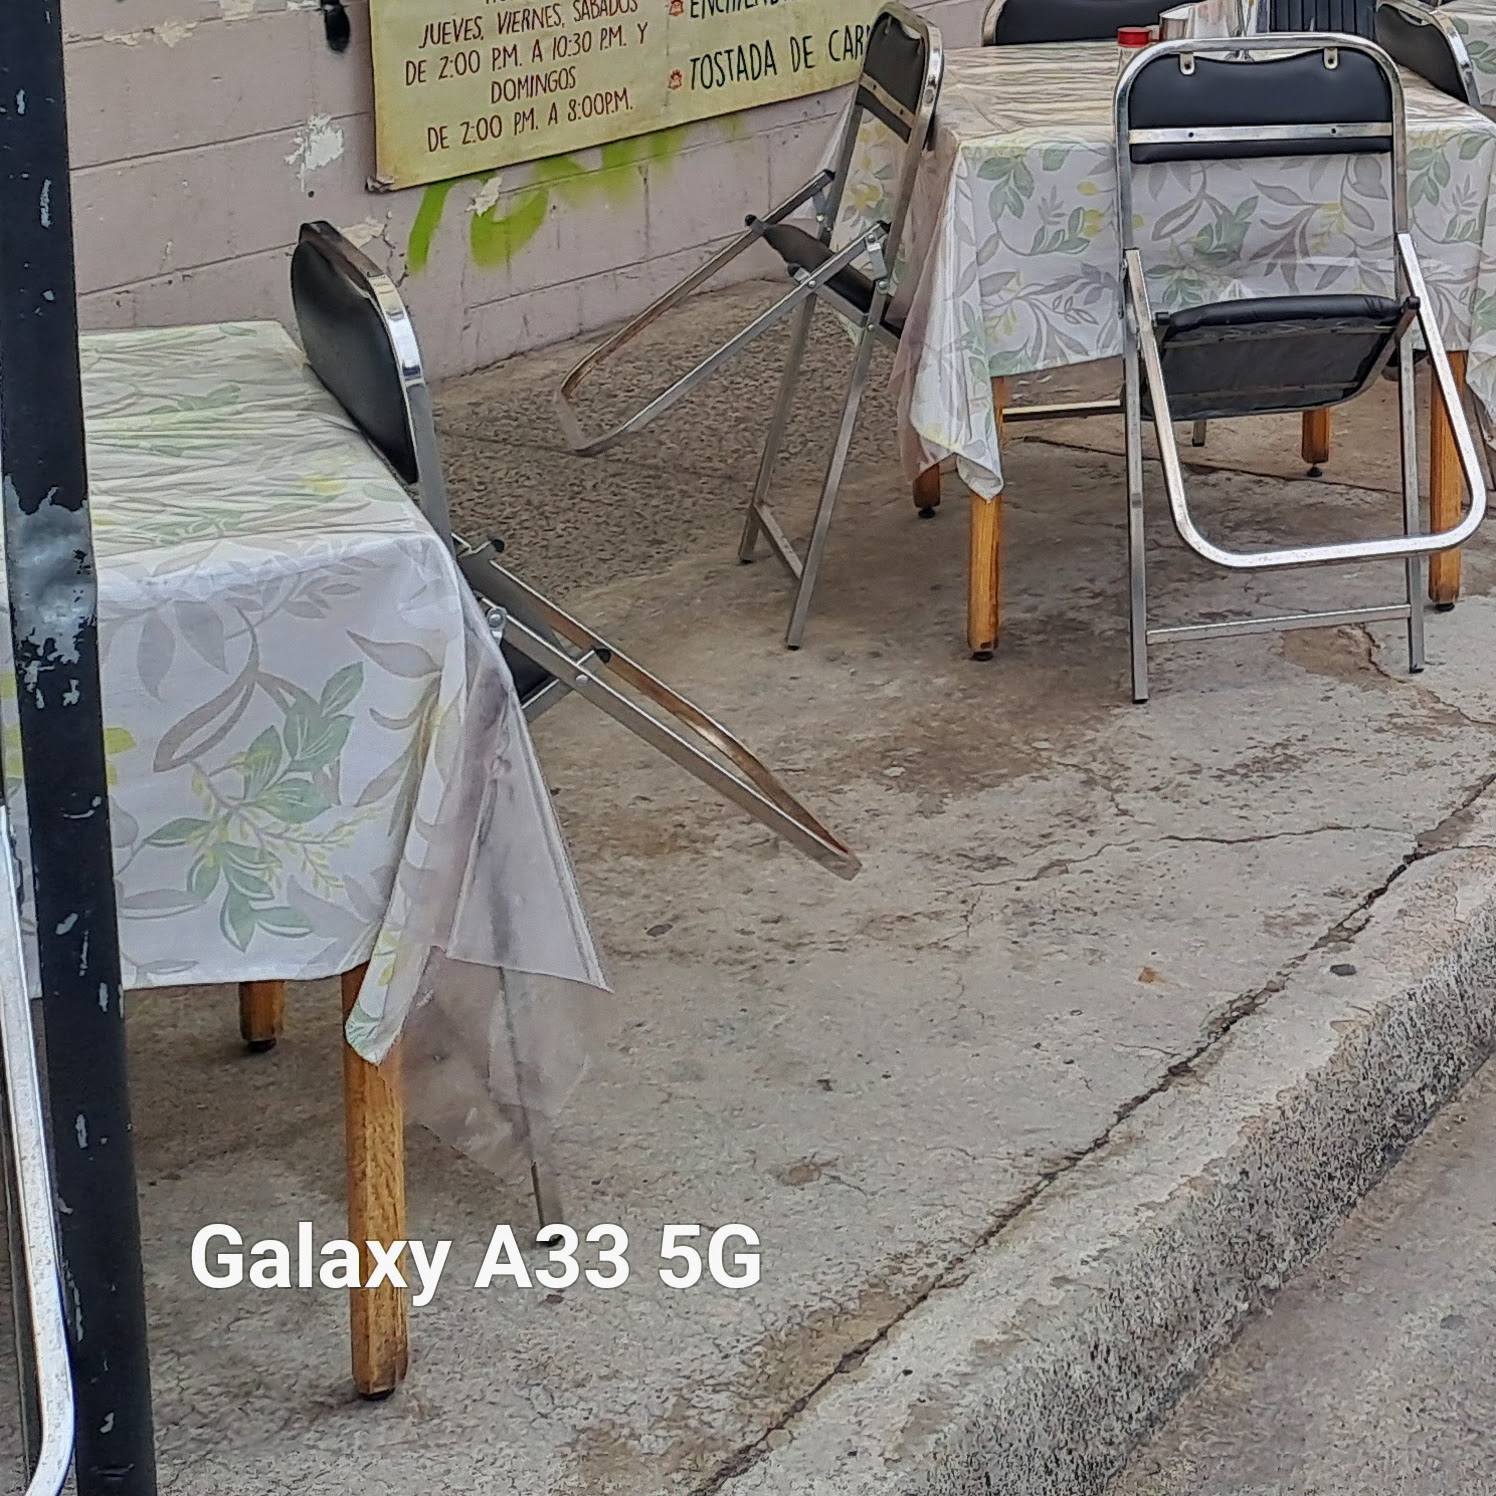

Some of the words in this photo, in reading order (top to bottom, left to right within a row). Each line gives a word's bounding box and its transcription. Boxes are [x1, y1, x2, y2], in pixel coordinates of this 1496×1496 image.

[405, 59, 427, 86] DE
[438, 50, 481, 80] 2:00
[492, 44, 523, 72] P.M.
[532, 39, 543, 63] A
[552, 31, 592, 61] 10:30
[600, 24, 627, 52] P.M.
[637, 21, 648, 45] Y
[690, 39, 777, 90] TOSTADA
[790, 35, 813, 72] DE
[490, 66, 576, 104] DOMINGOS
[427, 125, 449, 152] DE
[461, 114, 503, 145] 2:00
[514, 107, 539, 136] P.M.
[547, 102, 558, 126] A
